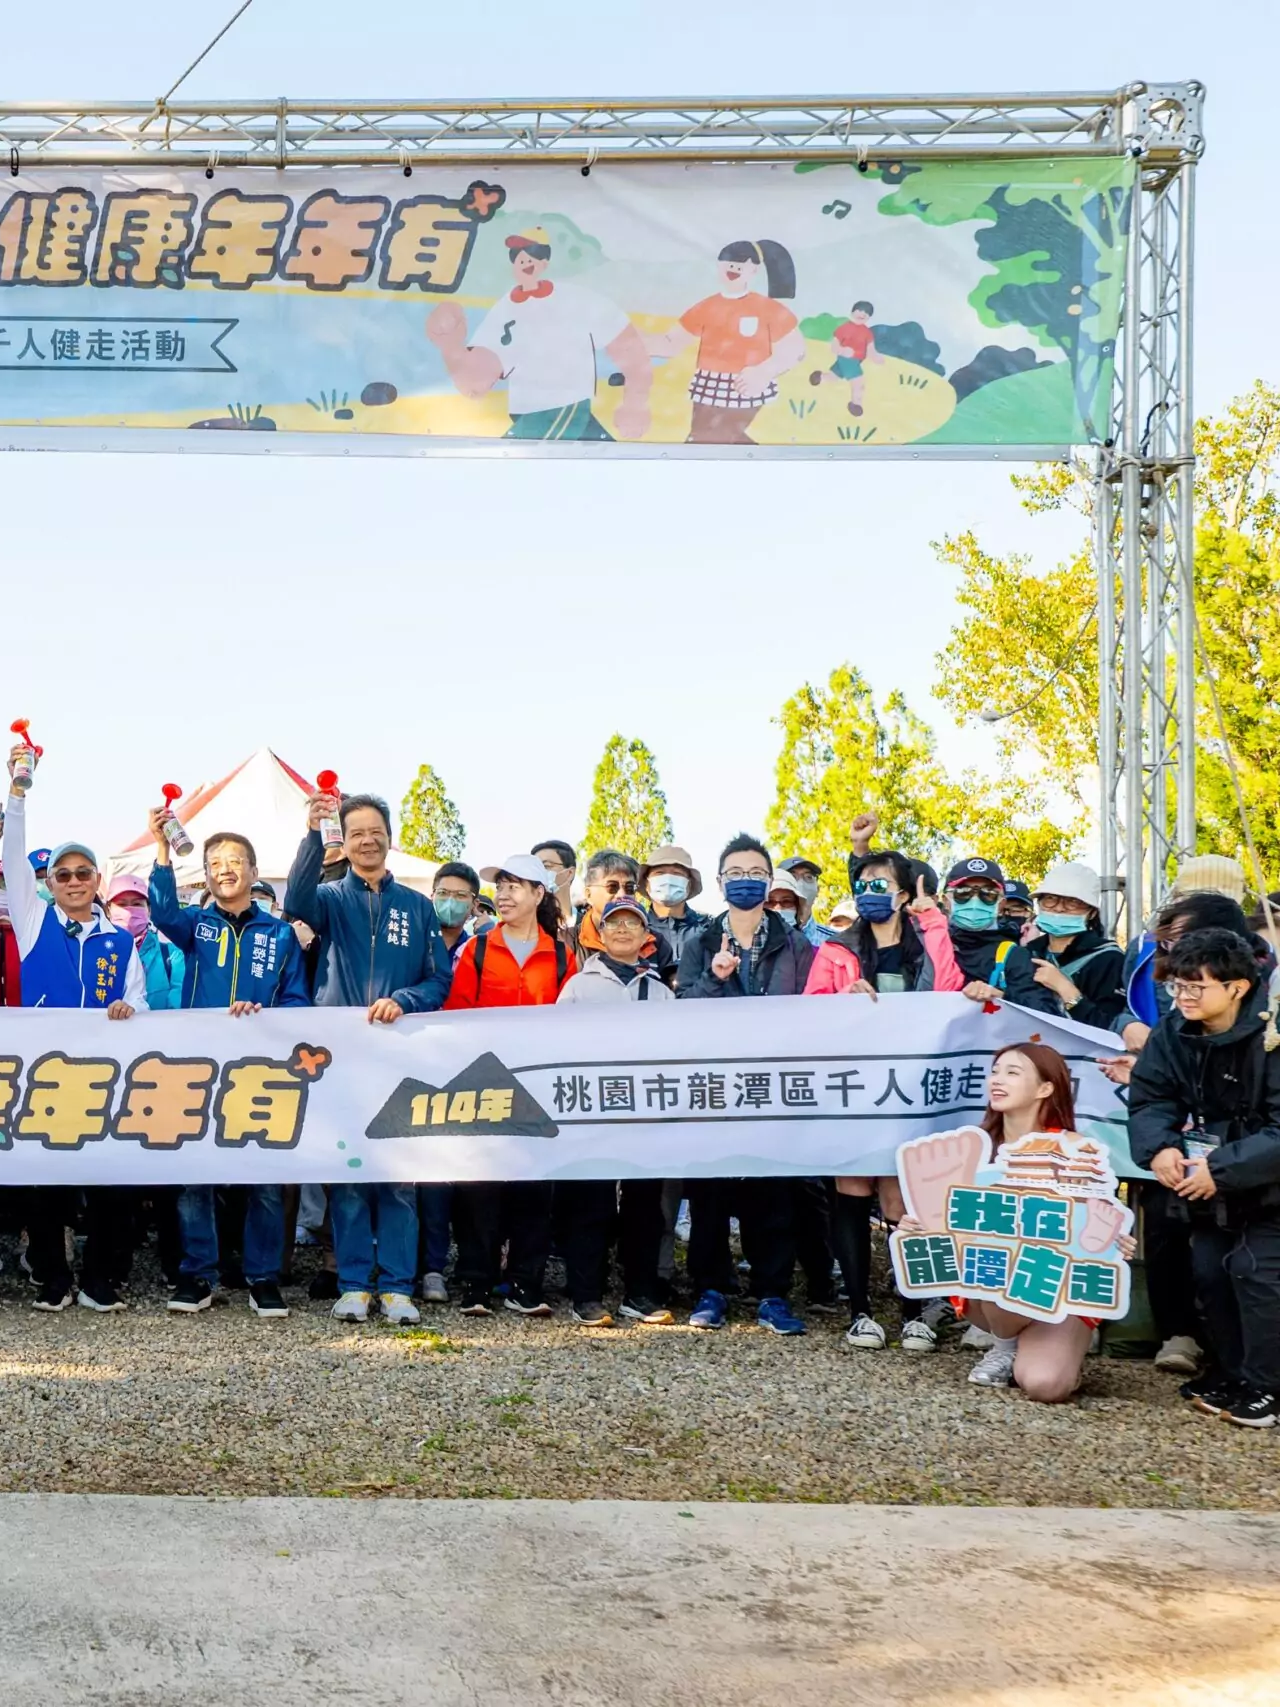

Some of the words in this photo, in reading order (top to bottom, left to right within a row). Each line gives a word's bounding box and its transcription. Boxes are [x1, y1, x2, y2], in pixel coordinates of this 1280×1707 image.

[410, 1088, 514, 1126] 114年
[552, 1062, 1080, 1113] 桃園市龍潭區千人健走
[949, 1187, 1070, 1243] 我在
[901, 1233, 1117, 1311] 龍潭走走
